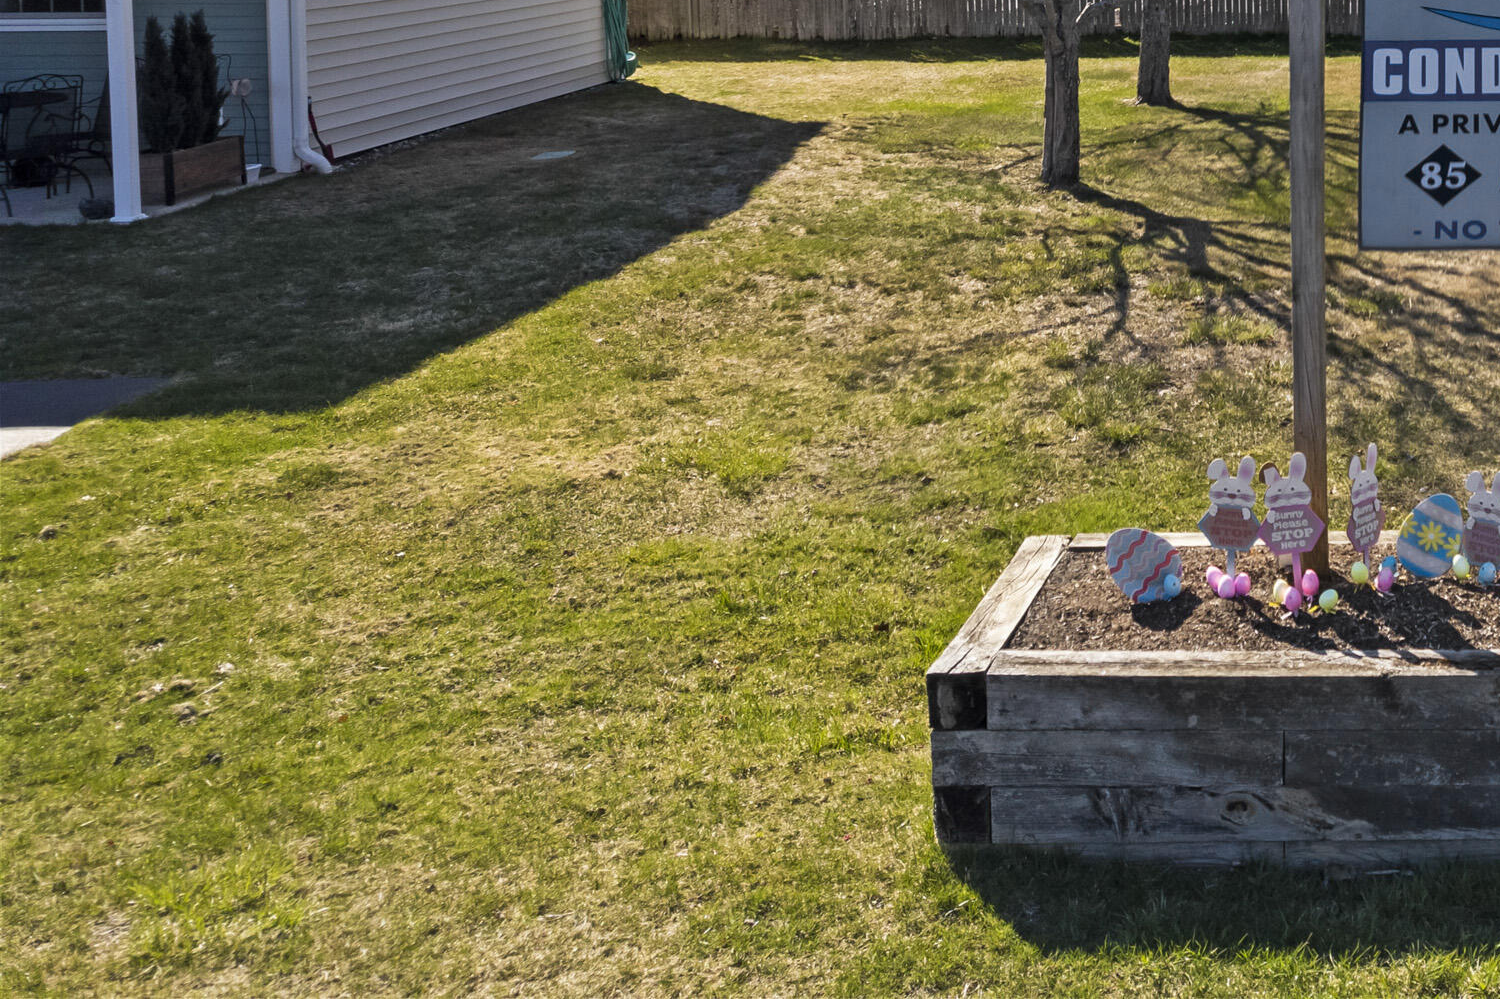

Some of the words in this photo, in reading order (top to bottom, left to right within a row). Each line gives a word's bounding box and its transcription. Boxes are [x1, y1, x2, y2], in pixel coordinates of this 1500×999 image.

[1398, 114, 1420, 135] A
[1419, 161, 1468, 190] 85
[1434, 220, 1487, 240] NO
[1273, 519, 1308, 530] Please
[1271, 528, 1314, 541] STOP
[1281, 540, 1306, 549] Here
